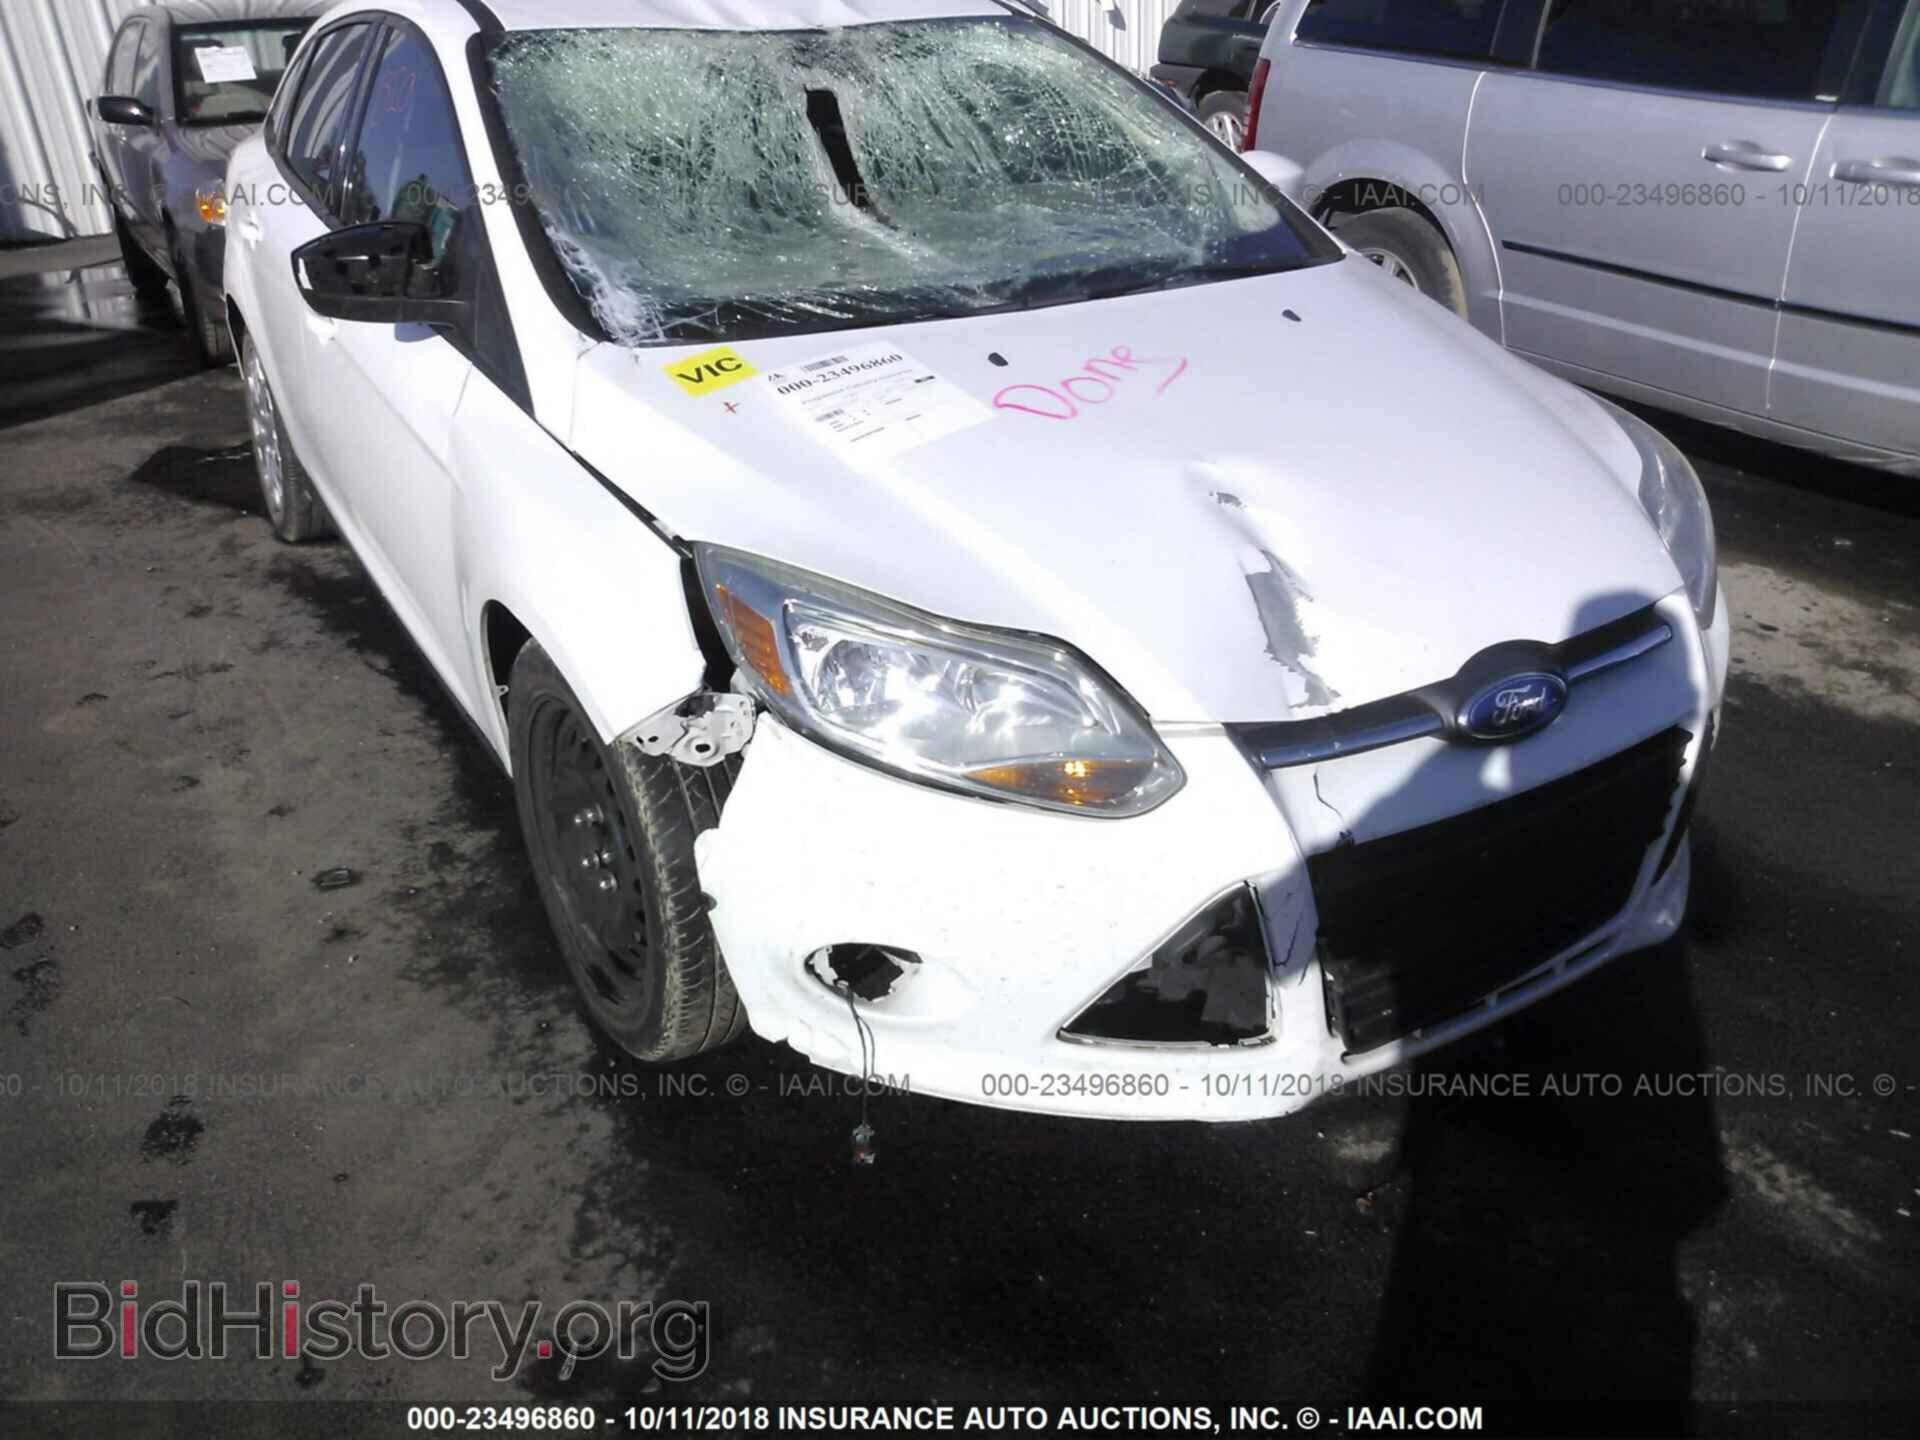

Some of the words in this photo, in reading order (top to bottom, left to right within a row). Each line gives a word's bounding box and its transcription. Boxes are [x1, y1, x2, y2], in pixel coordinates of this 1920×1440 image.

[677, 356, 744, 385] VIC
[776, 353, 904, 396] 000-23496860
[1491, 684, 1547, 725] Ford
